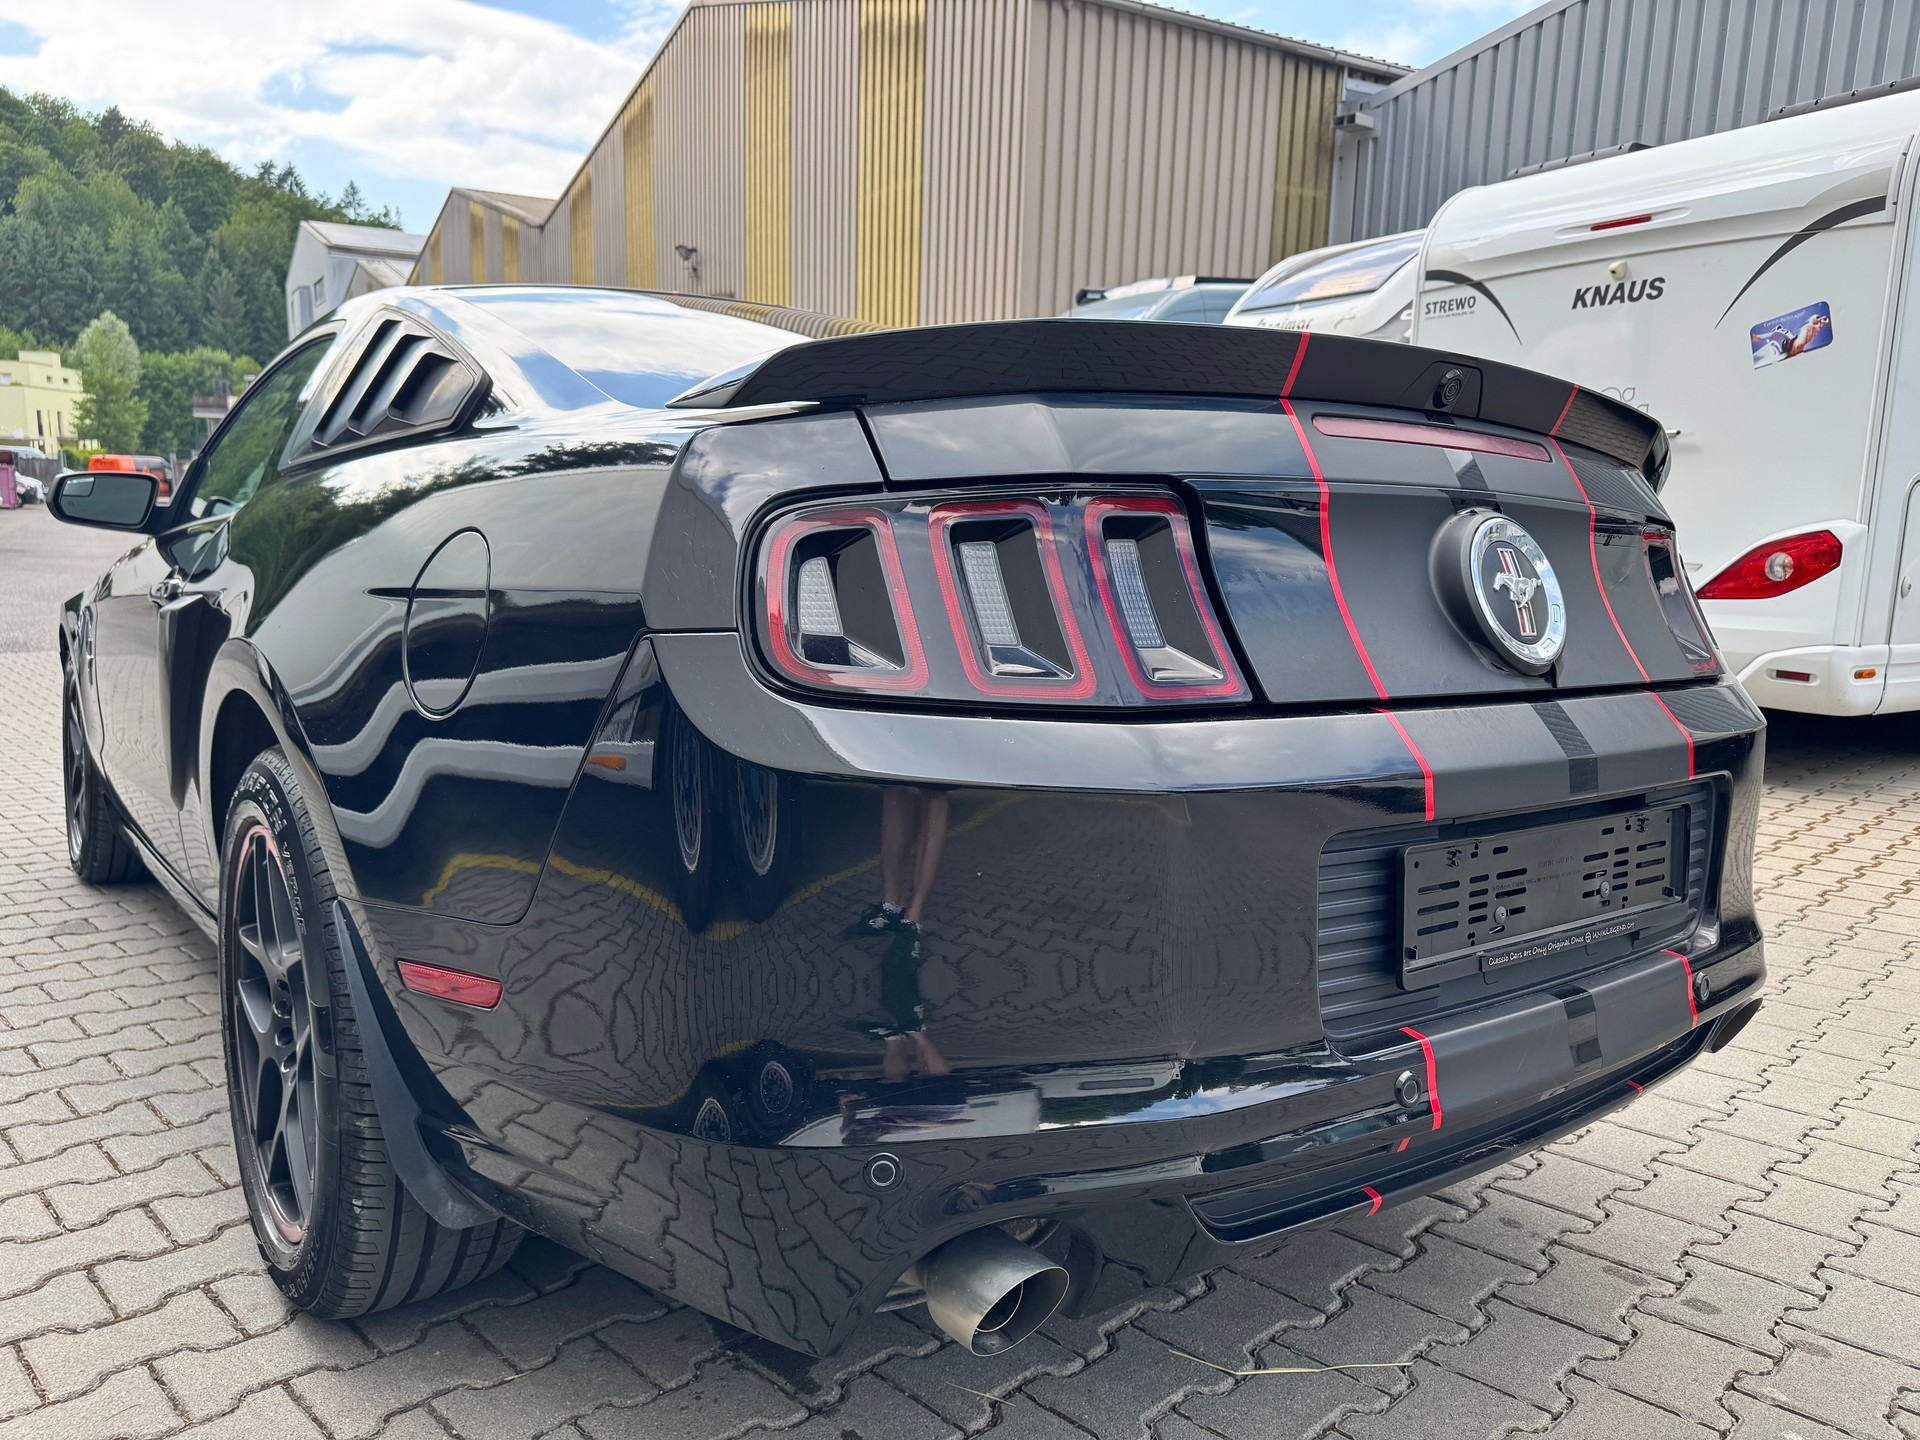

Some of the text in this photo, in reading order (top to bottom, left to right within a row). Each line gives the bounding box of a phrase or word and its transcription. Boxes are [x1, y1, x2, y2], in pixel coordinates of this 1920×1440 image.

[1571, 276, 1666, 310] KNAUS
[1425, 296, 1477, 315] STREWO
[1509, 951, 1523, 961] Cars
[1532, 945, 1547, 956] Only
[1547, 937, 1571, 951] Original
